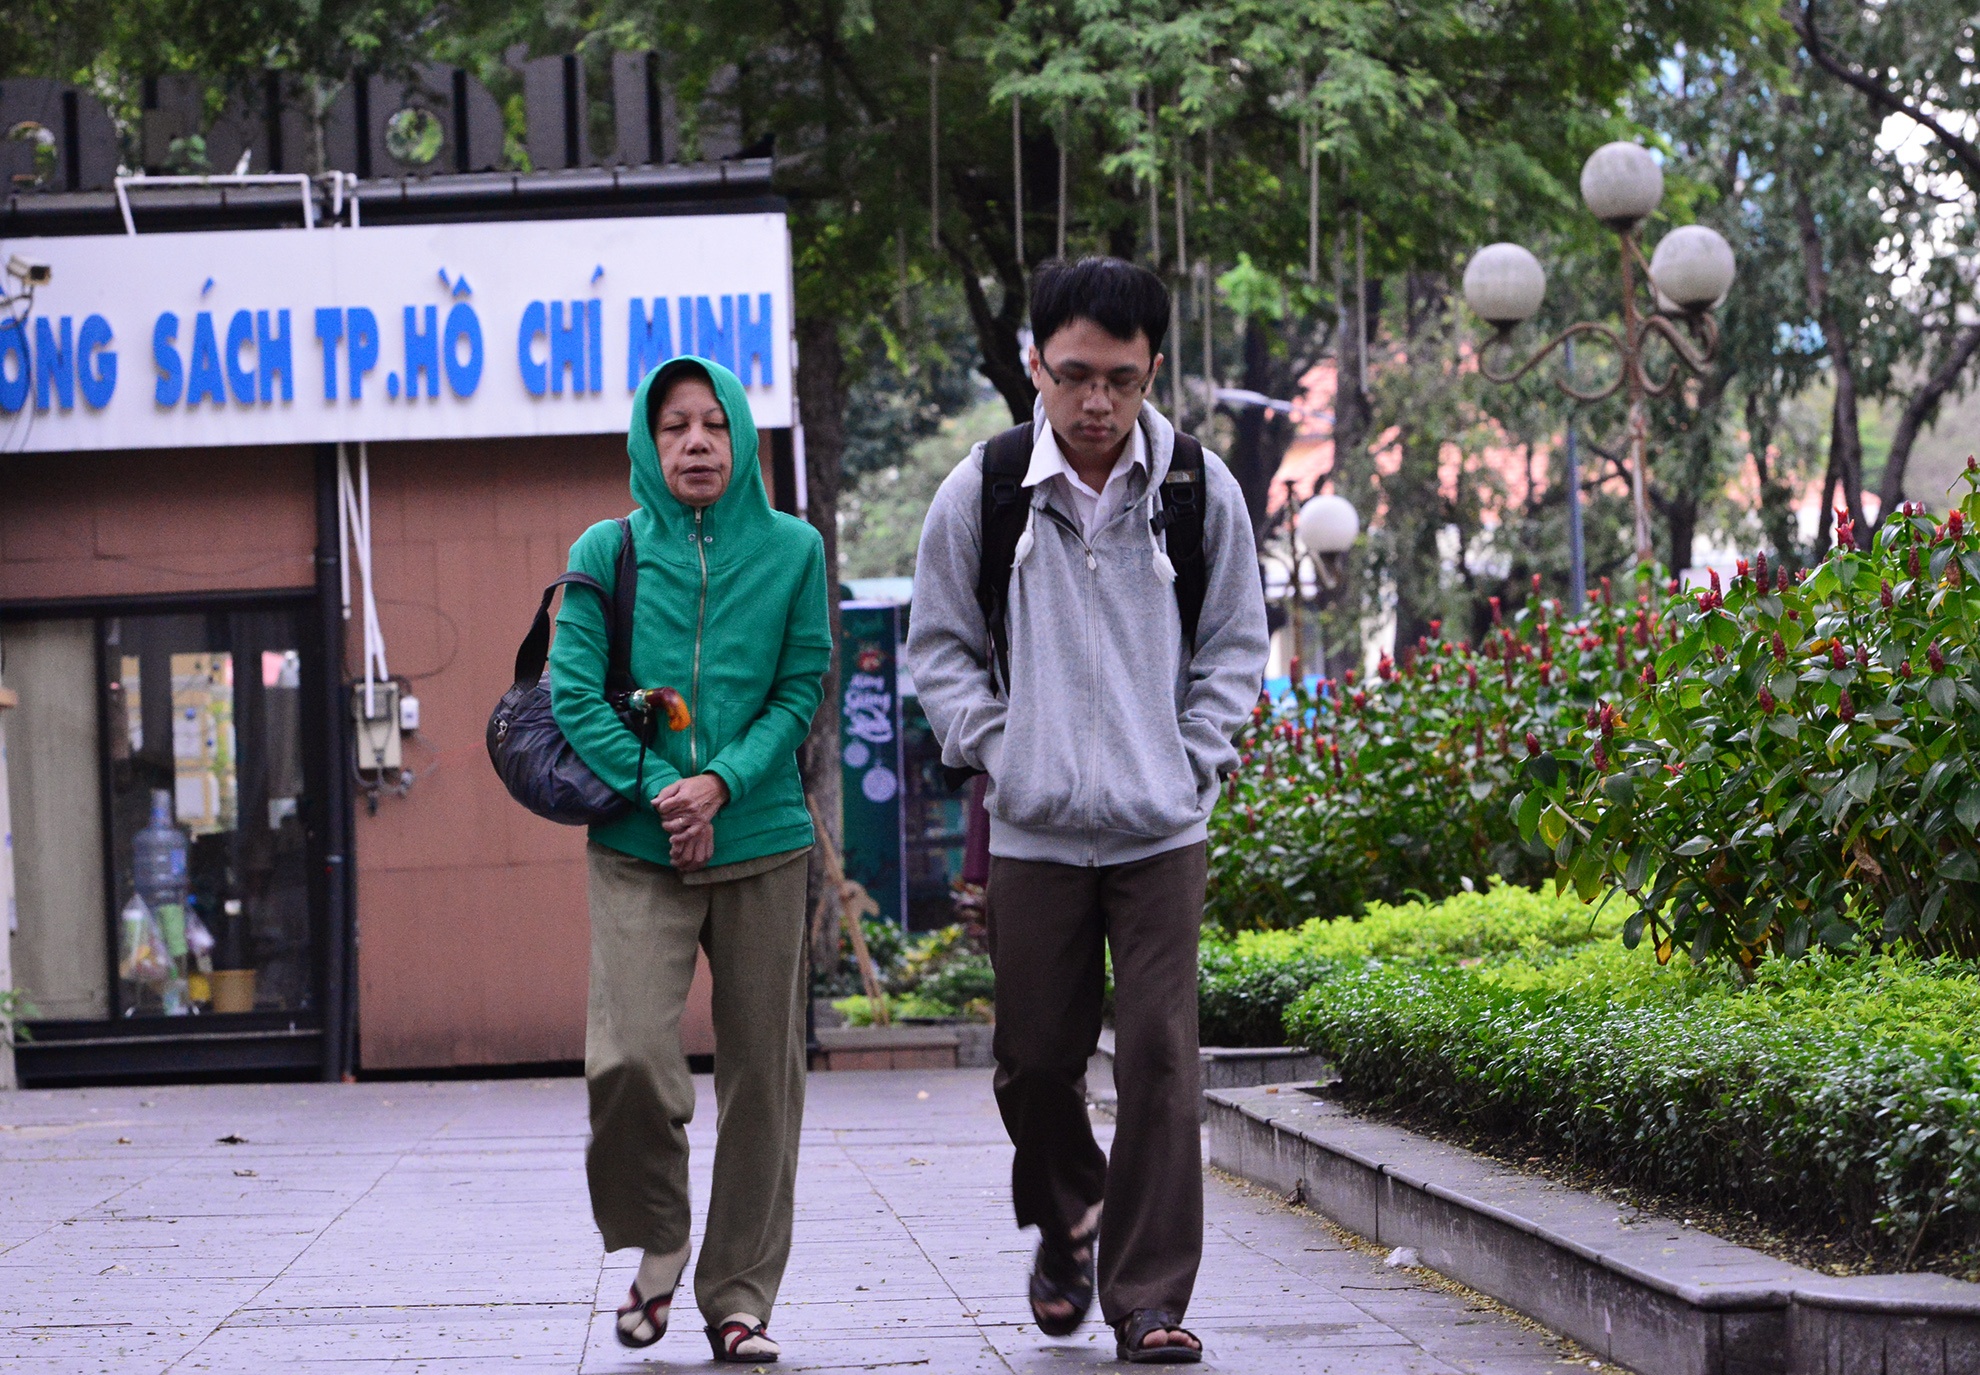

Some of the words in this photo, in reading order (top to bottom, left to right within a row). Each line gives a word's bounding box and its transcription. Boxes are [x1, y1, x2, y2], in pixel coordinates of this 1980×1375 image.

[152, 277, 294, 407] SÁCH
[517, 265, 604, 396] CHÍ
[627, 293, 774, 391] MINH
